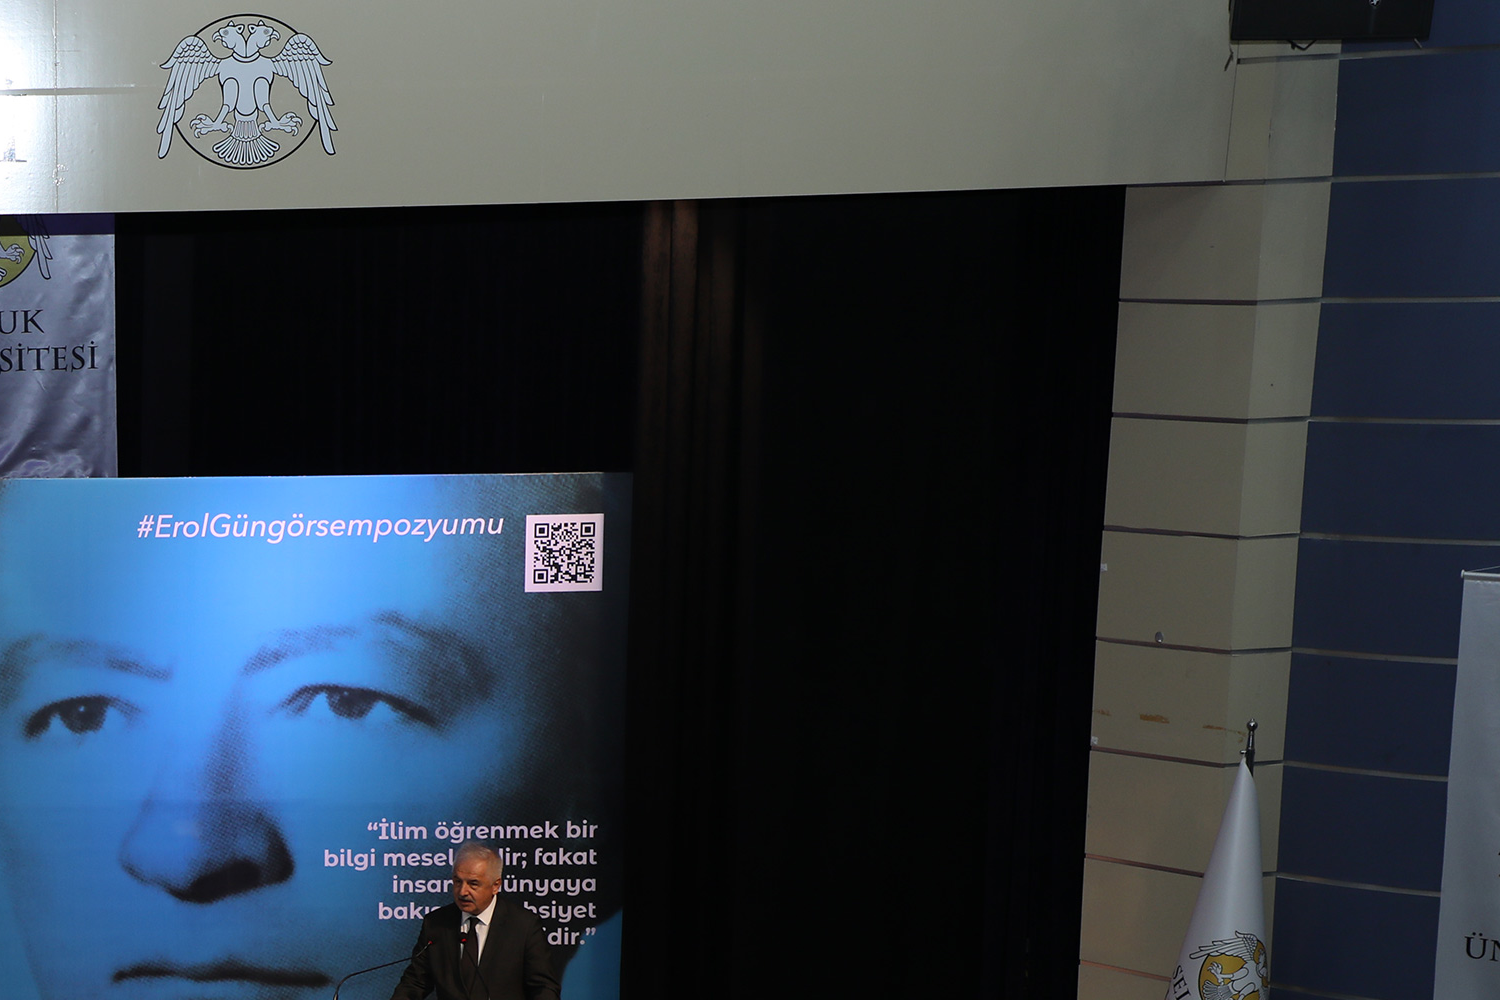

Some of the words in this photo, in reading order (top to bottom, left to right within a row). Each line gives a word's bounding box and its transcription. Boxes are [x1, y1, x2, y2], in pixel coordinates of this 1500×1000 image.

[137, 513, 505, 544] #ErolGüngörsempozyumu
[434, 820, 559, 844] öğrenmek
[566, 819, 598, 838] bir
[324, 848, 376, 872] bilgi
[534, 847, 598, 866] fakat
[392, 874, 454, 894] insan
[497, 874, 596, 897] ünyaya
[523, 900, 597, 923] siyet
